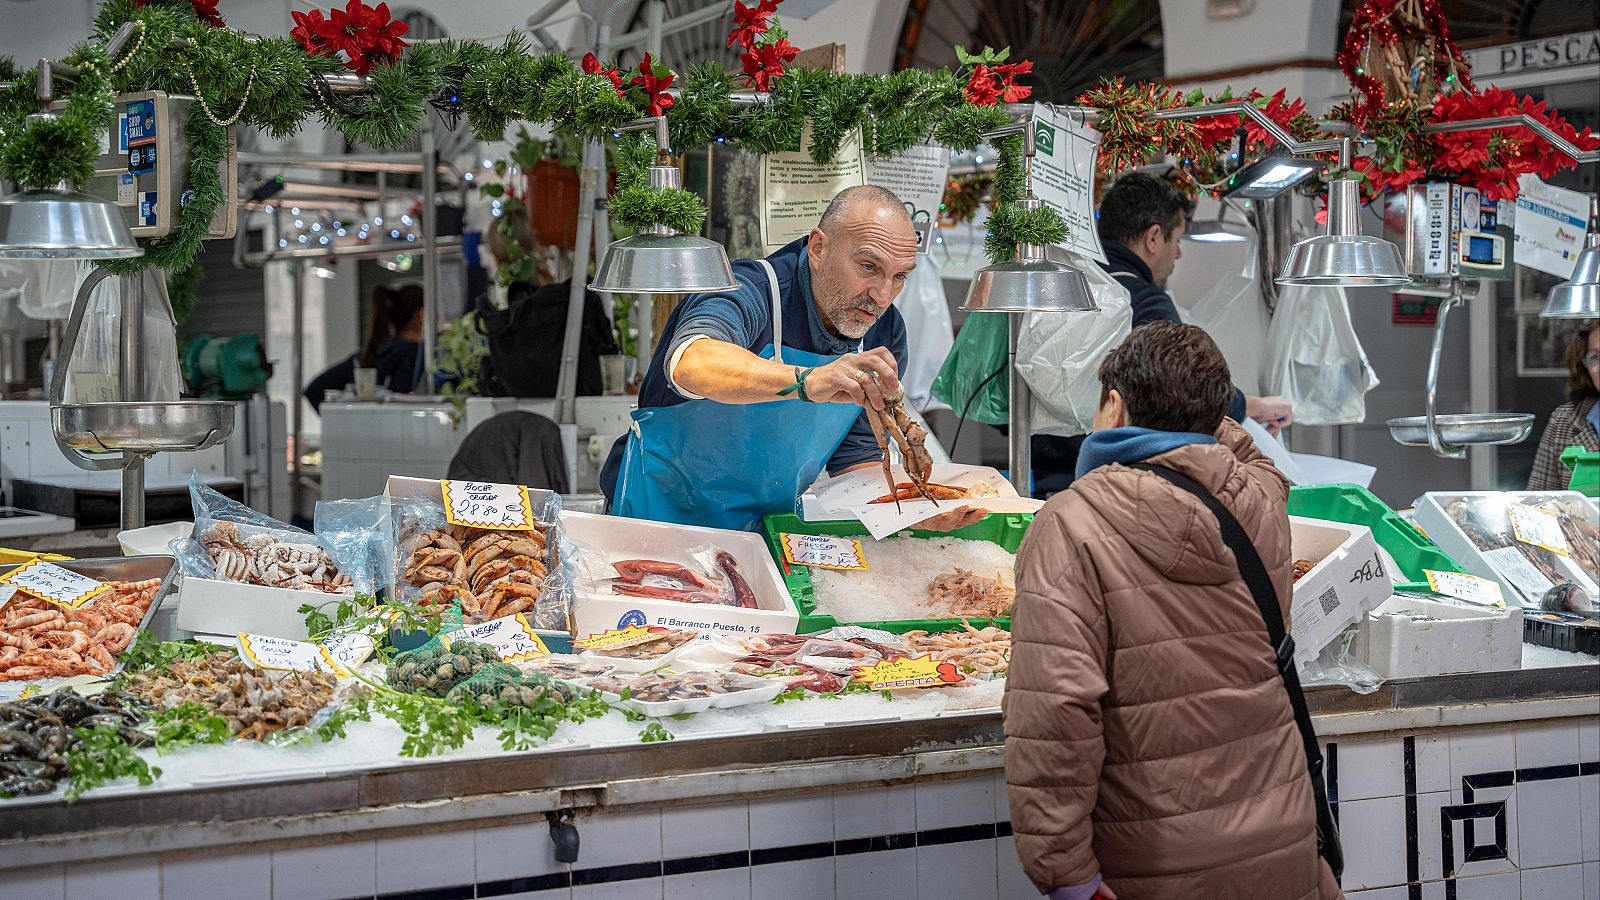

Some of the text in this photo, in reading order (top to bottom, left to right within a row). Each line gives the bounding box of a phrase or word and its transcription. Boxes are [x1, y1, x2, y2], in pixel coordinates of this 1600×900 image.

[128, 115, 141, 127] SHOP
[128, 125, 144, 139] SMALL
[657, 617, 667, 625] El
[668, 618, 710, 629] Barranco
[712, 622, 746, 633] Puesto,
[750, 625, 761, 634] 15
[874, 677, 936, 689] OFERTA
